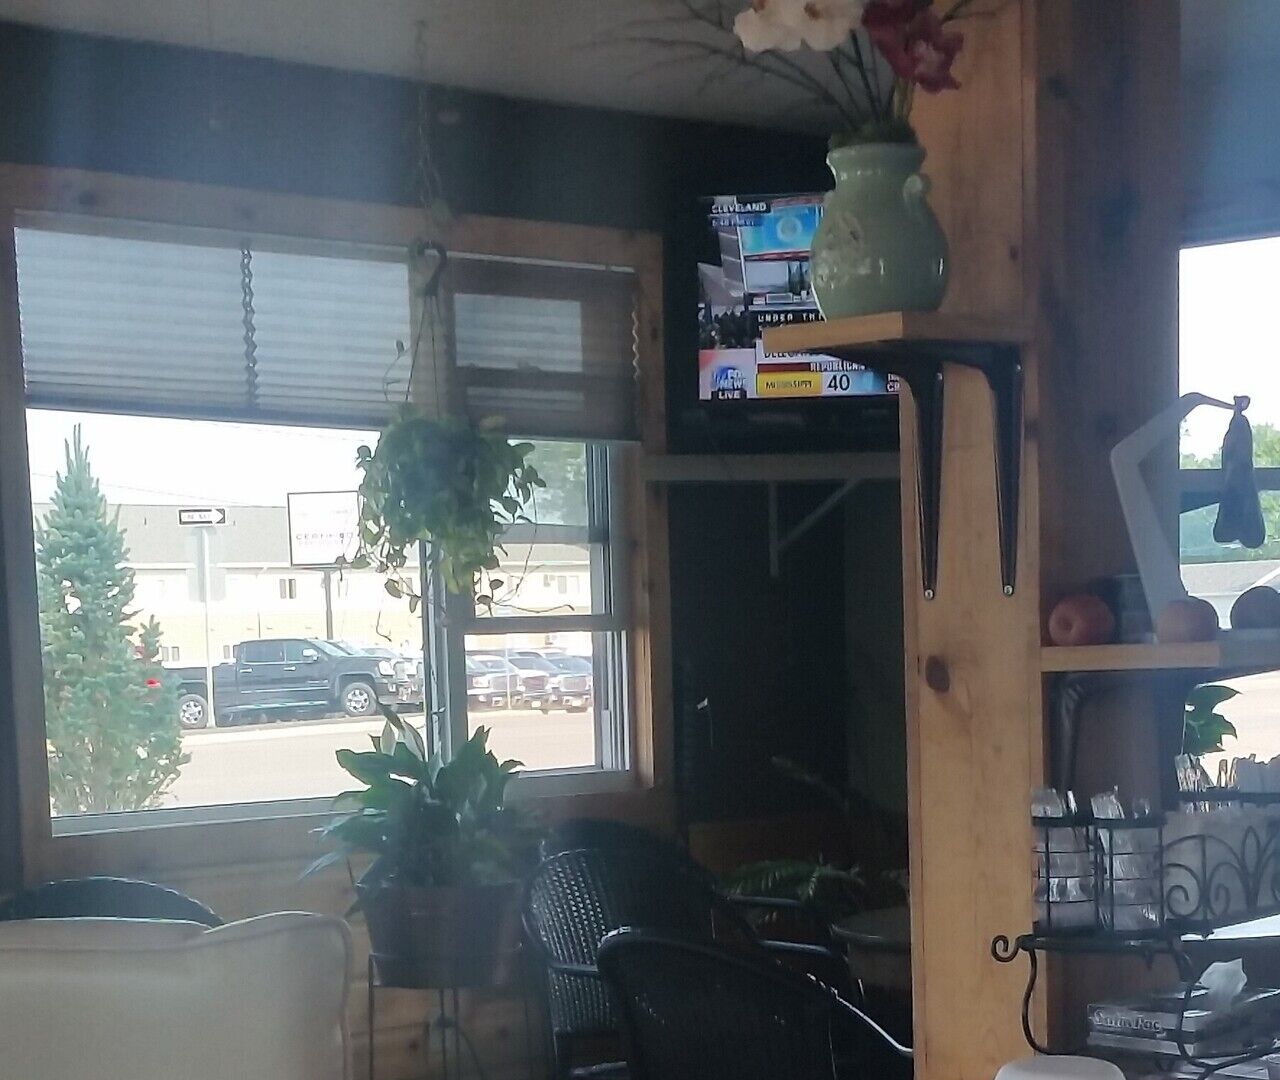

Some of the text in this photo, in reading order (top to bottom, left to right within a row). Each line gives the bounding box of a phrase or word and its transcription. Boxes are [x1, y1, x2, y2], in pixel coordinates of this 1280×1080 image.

[711, 202, 768, 214] CLEVELAND
[827, 373, 851, 392] 40
[718, 390, 741, 400] LIVE
